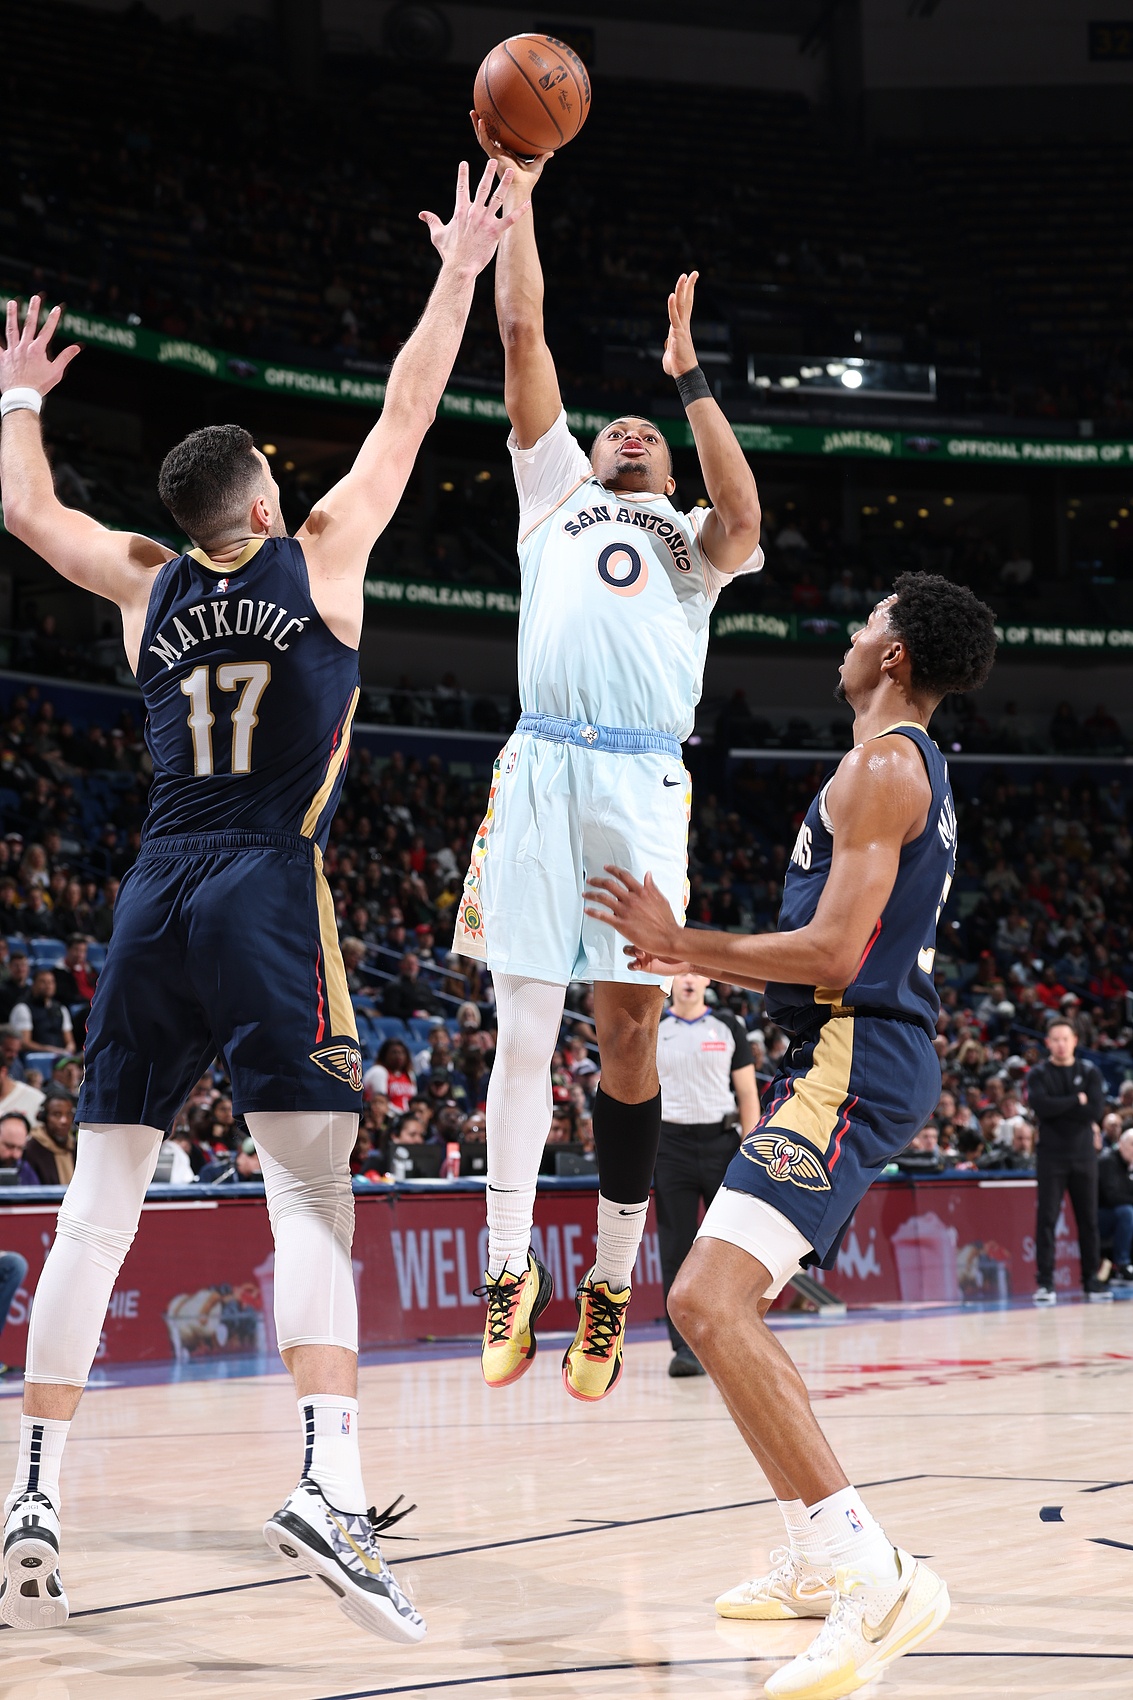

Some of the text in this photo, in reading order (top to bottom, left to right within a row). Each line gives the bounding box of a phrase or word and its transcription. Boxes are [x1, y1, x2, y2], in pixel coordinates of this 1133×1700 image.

[63, 313, 137, 349] PELICANS
[157, 341, 219, 374] JAMESON
[264, 367, 386, 399] OFFICIAL PART
[443, 393, 472, 415] THE
[822, 430, 893, 454] JAMESON
[948, 439, 1020, 459] OFFICIAL
[1022, 442, 1099, 461] PARTNER
[1101, 444, 1125, 461] OF
[562, 504, 691, 573] SAN ANTONIO
[596, 541, 647, 596] 0
[365, 580, 520, 613] NEW ORLEANS PELI
[148, 598, 311, 670] MATKOVIĆ
[715, 613, 790, 639] JAMESON
[1006, 626, 1029, 644] OF
[1032, 627, 1064, 646] THE
[1066, 629, 1106, 647] NEW
[180, 660, 272, 777] 17
[390, 1223, 584, 1311] WELME
